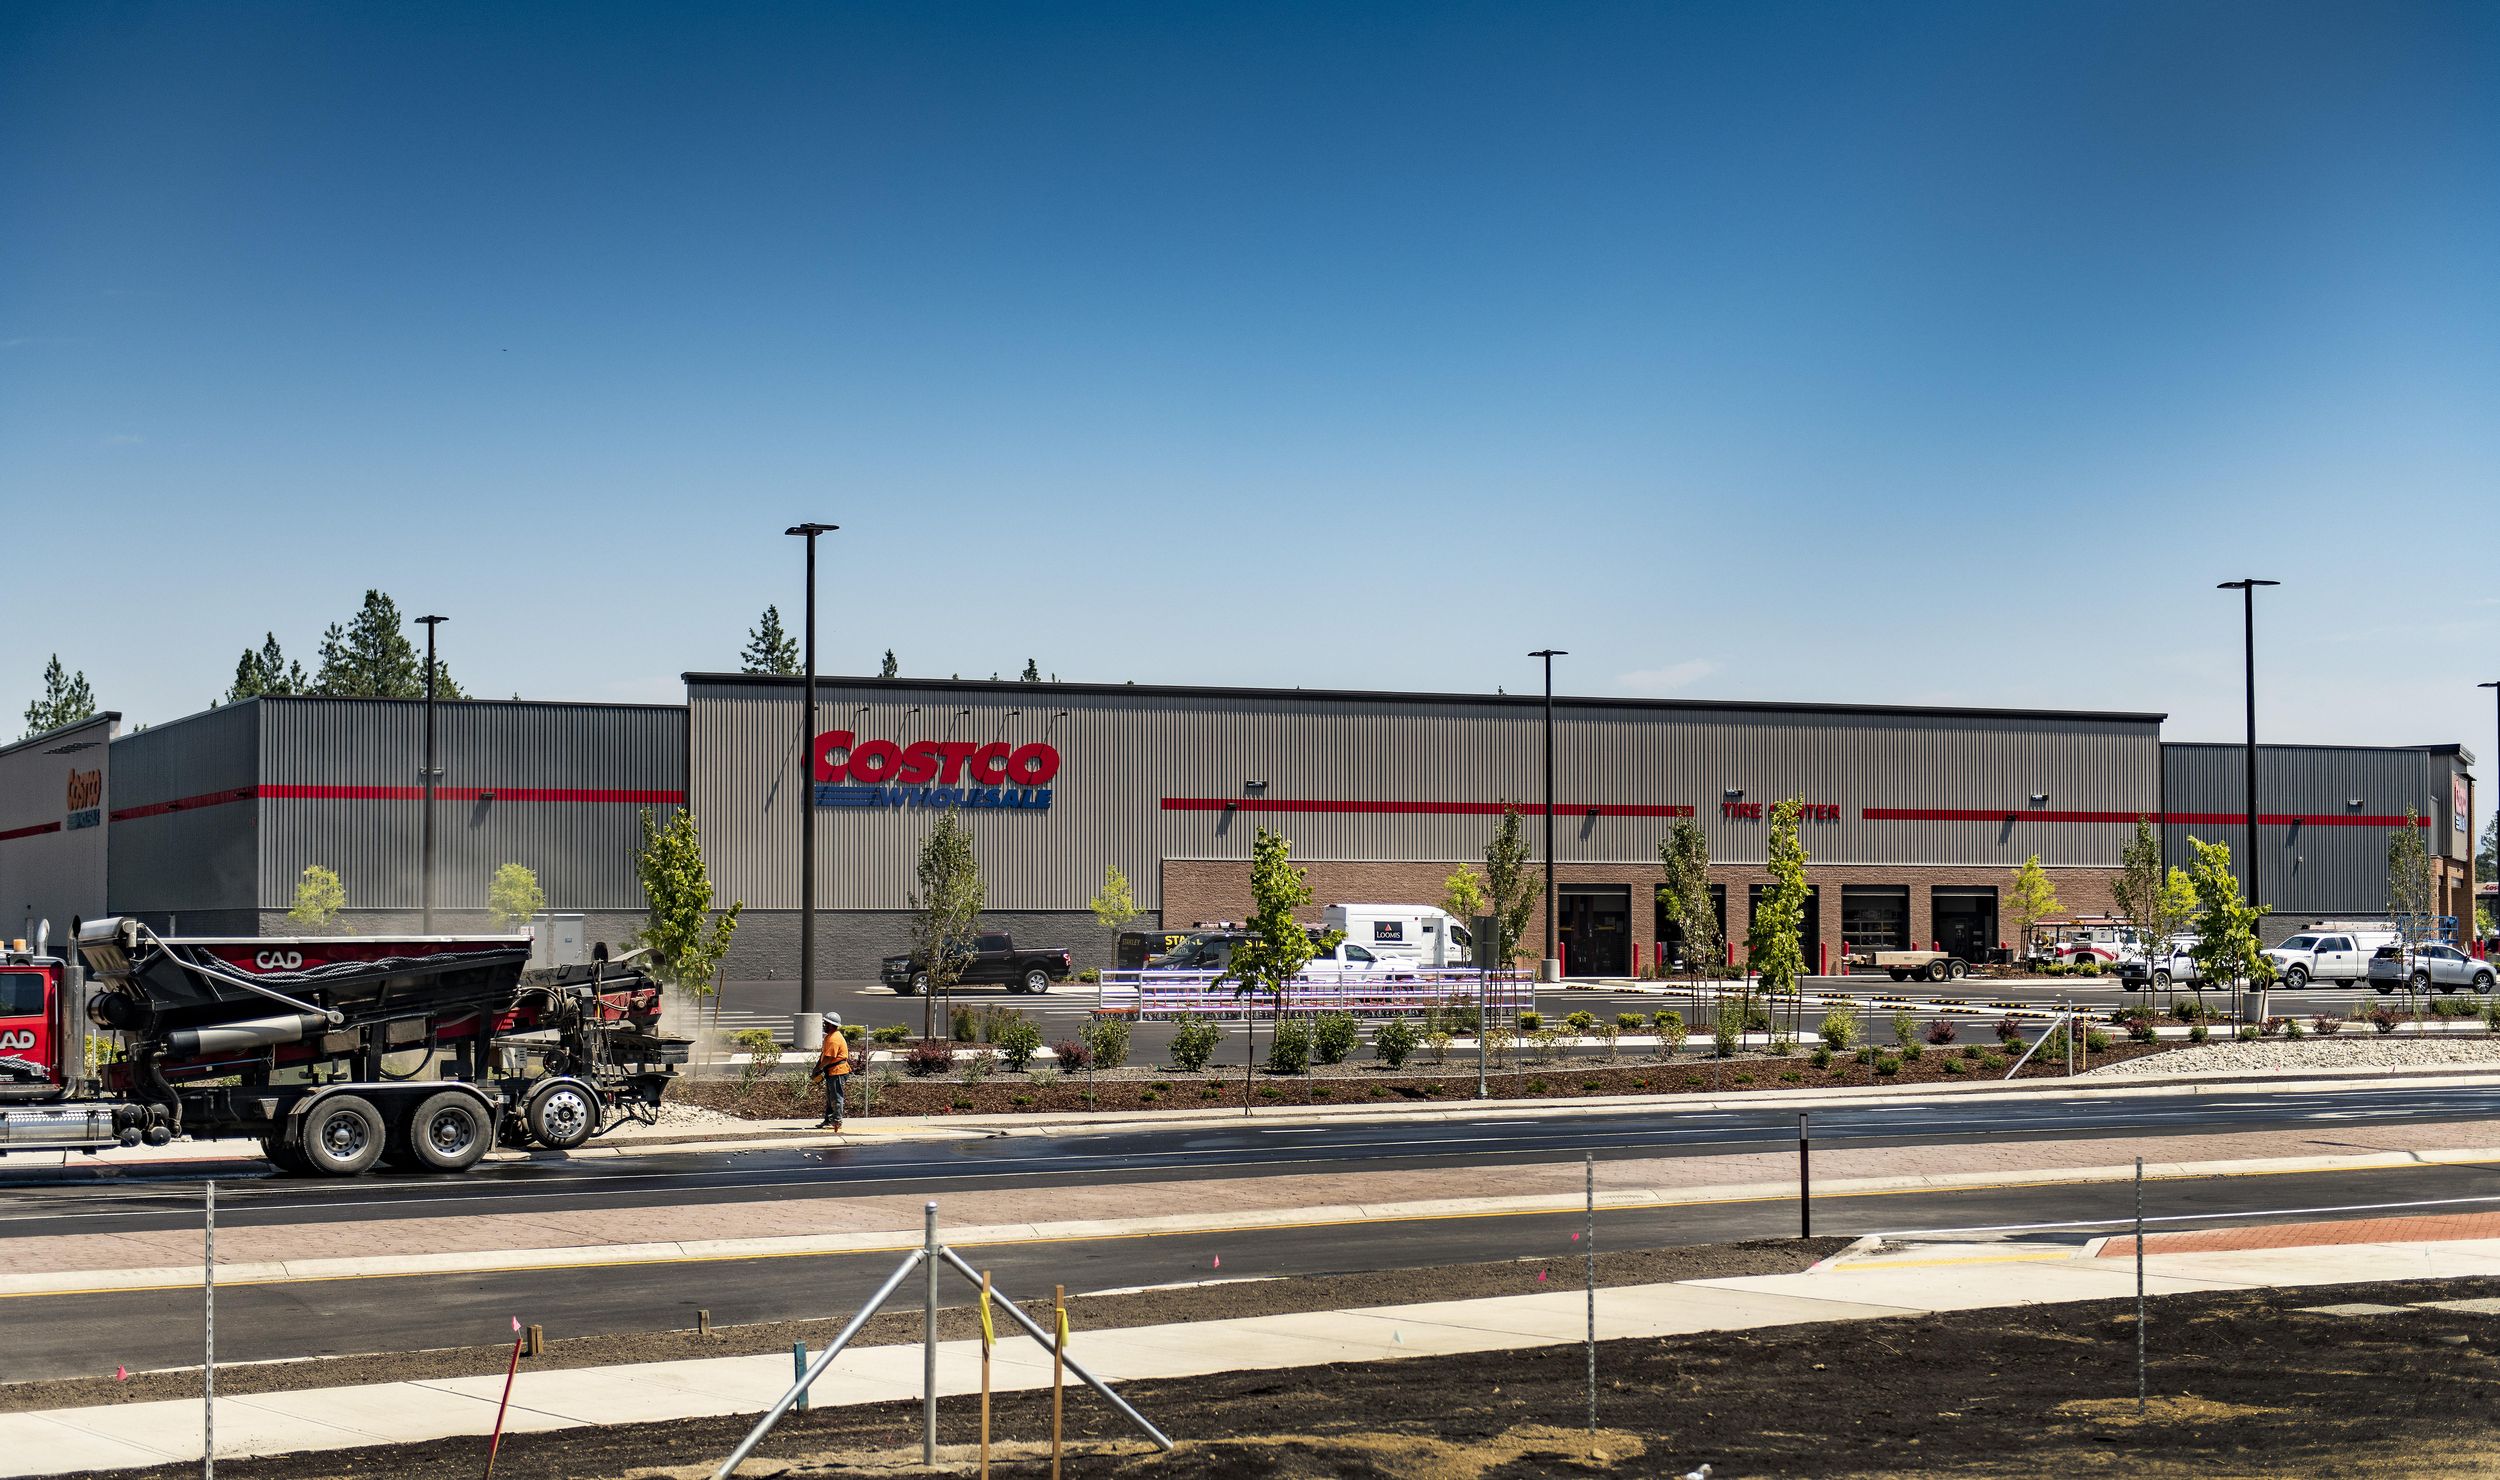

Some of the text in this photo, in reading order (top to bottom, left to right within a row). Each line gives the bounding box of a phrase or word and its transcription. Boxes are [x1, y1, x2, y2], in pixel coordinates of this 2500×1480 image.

[801, 730, 1060, 785] COSTCO
[880, 787, 1052, 809] WHOLESALE
[1721, 802, 1762, 819] TIRE
[1376, 931, 1400, 939] LOOMIS
[256, 951, 302, 969] CAD
[0, 1030, 36, 1050] AD
